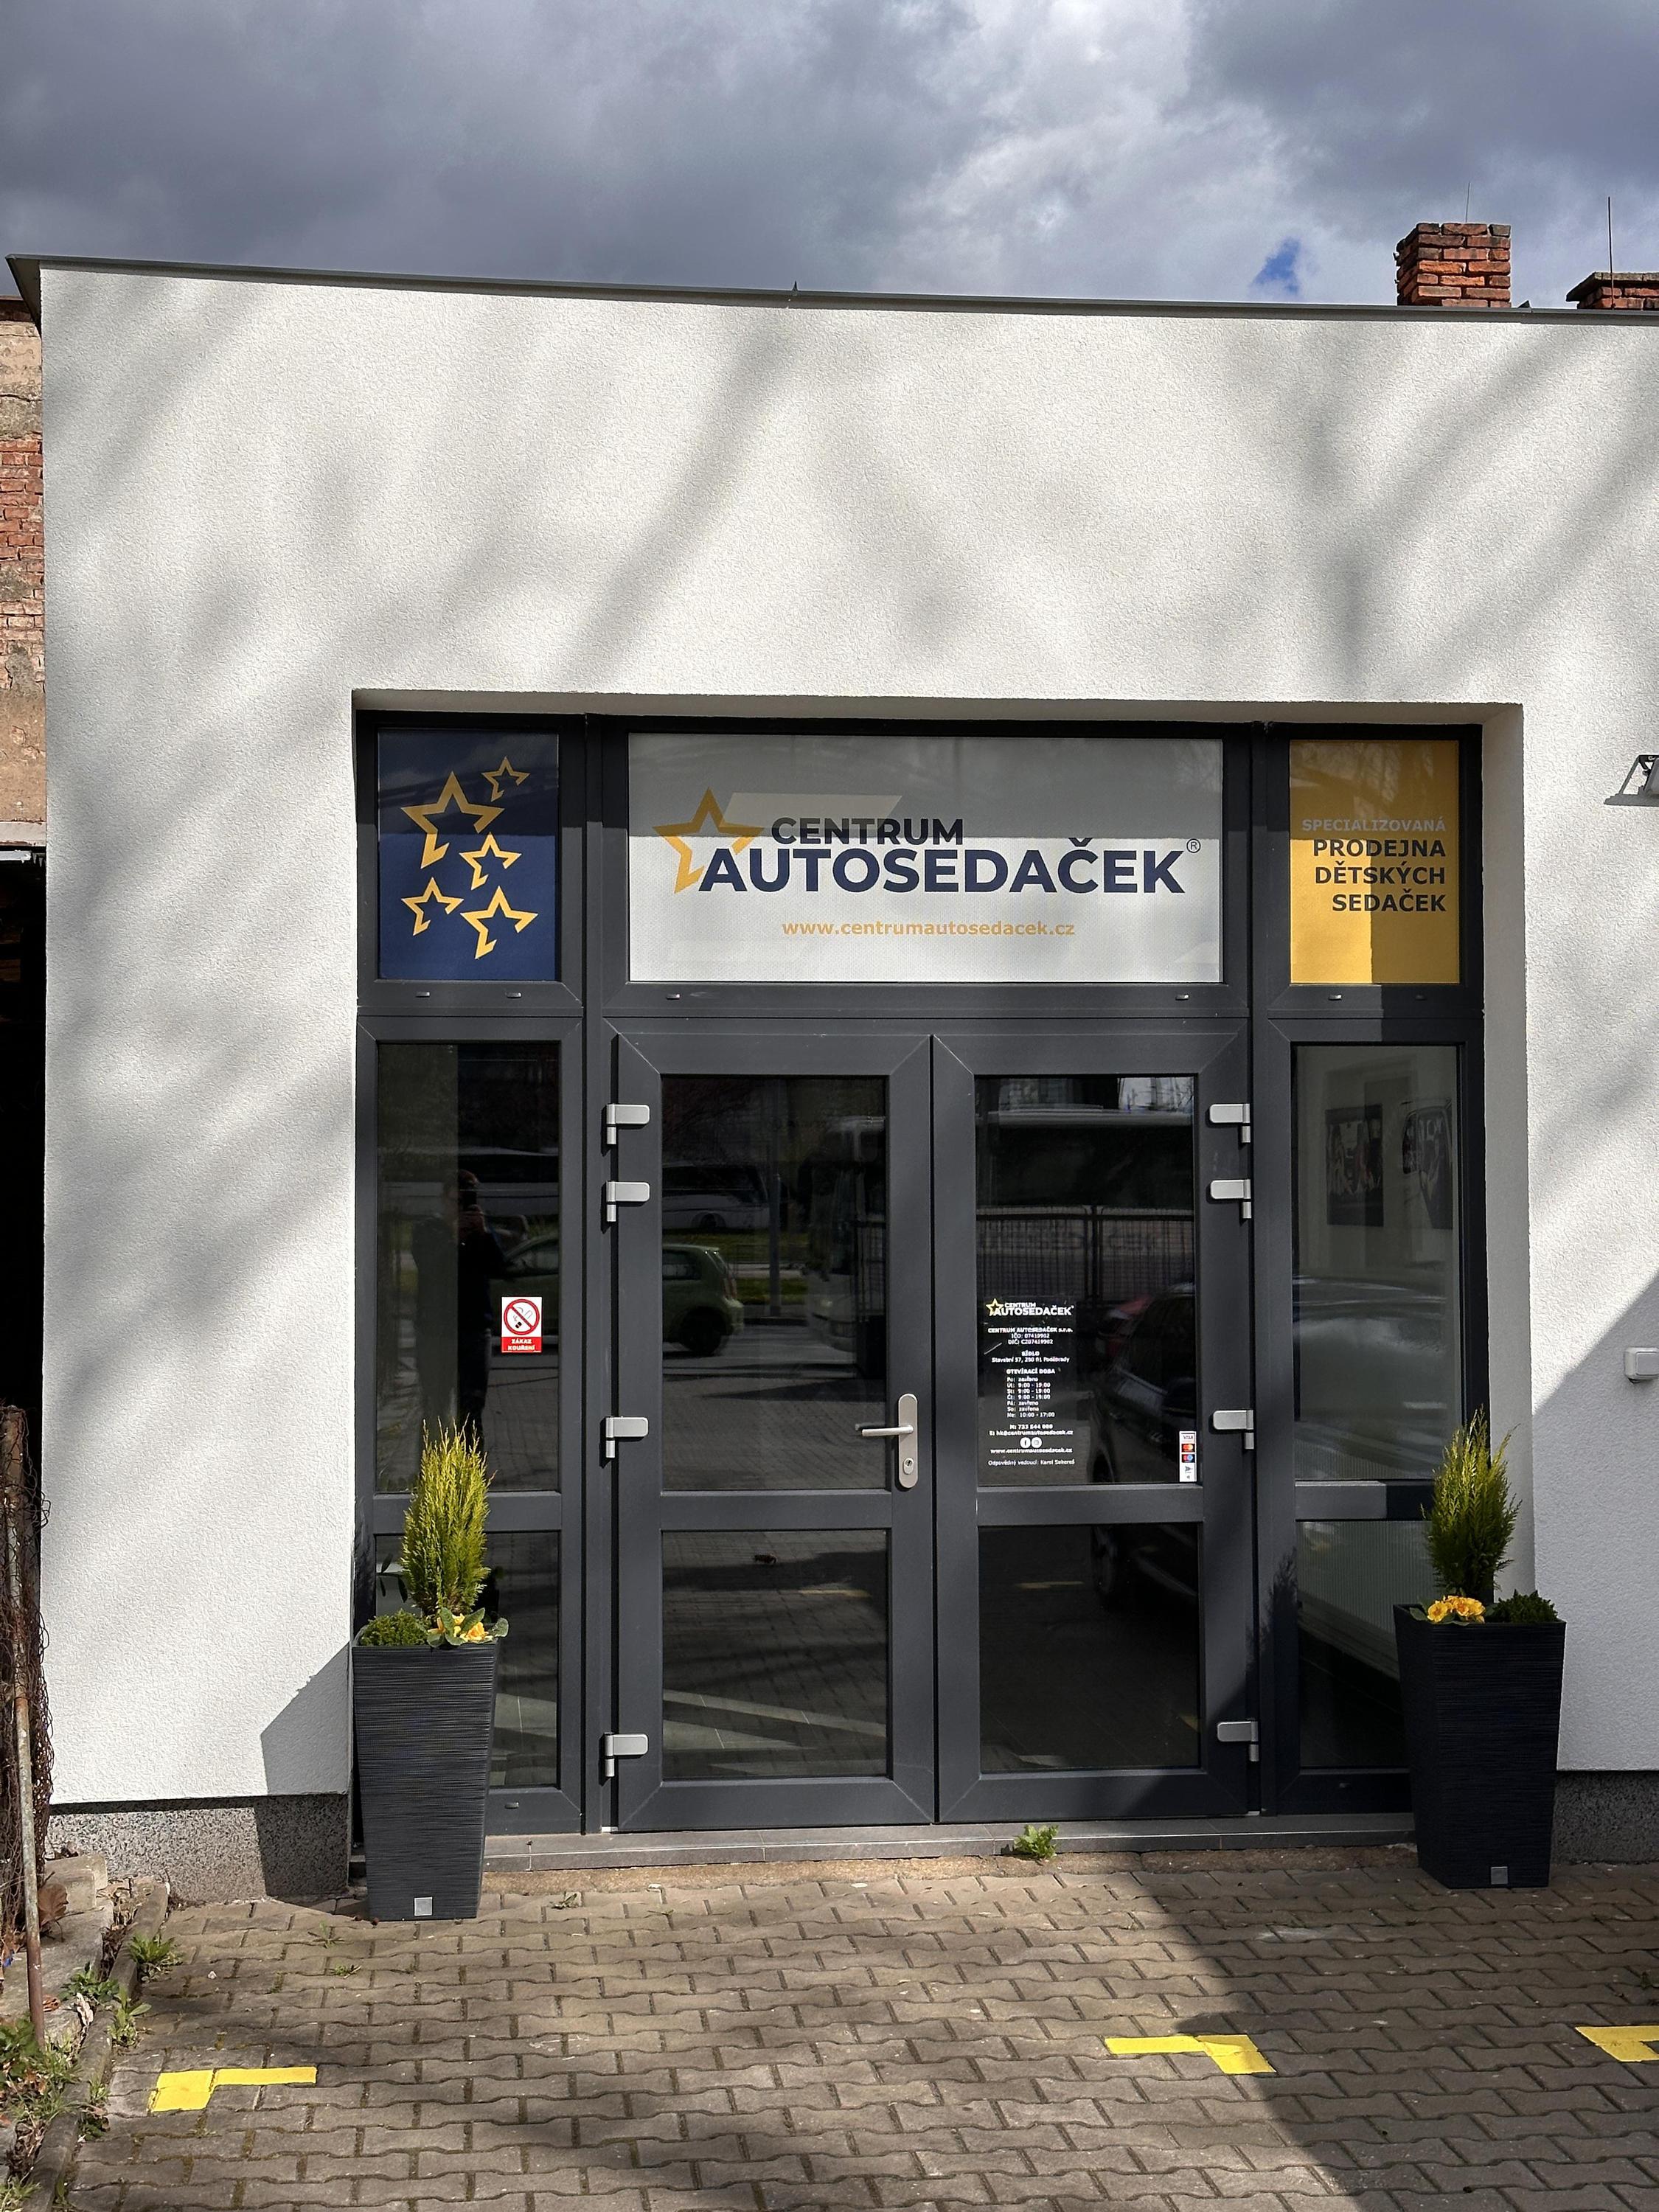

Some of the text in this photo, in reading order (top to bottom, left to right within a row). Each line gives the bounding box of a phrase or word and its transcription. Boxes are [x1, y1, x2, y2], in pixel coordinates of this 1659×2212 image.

[771, 817, 963, 845] CENTRUM
[1302, 816, 1446, 832] SPECIALIZOVANÁ
[1313, 839, 1446, 857] PRODEJNA
[698, 837, 1186, 894] AUTOSEDAČEK
[1315, 860, 1445, 884] DĚTSKÝCH
[1332, 888, 1447, 912] SEDAČEK
[782, 920, 1075, 935] www.centrumautosedacek.cz
[993, 1305, 1072, 1316] AUTOSEDAČEK
